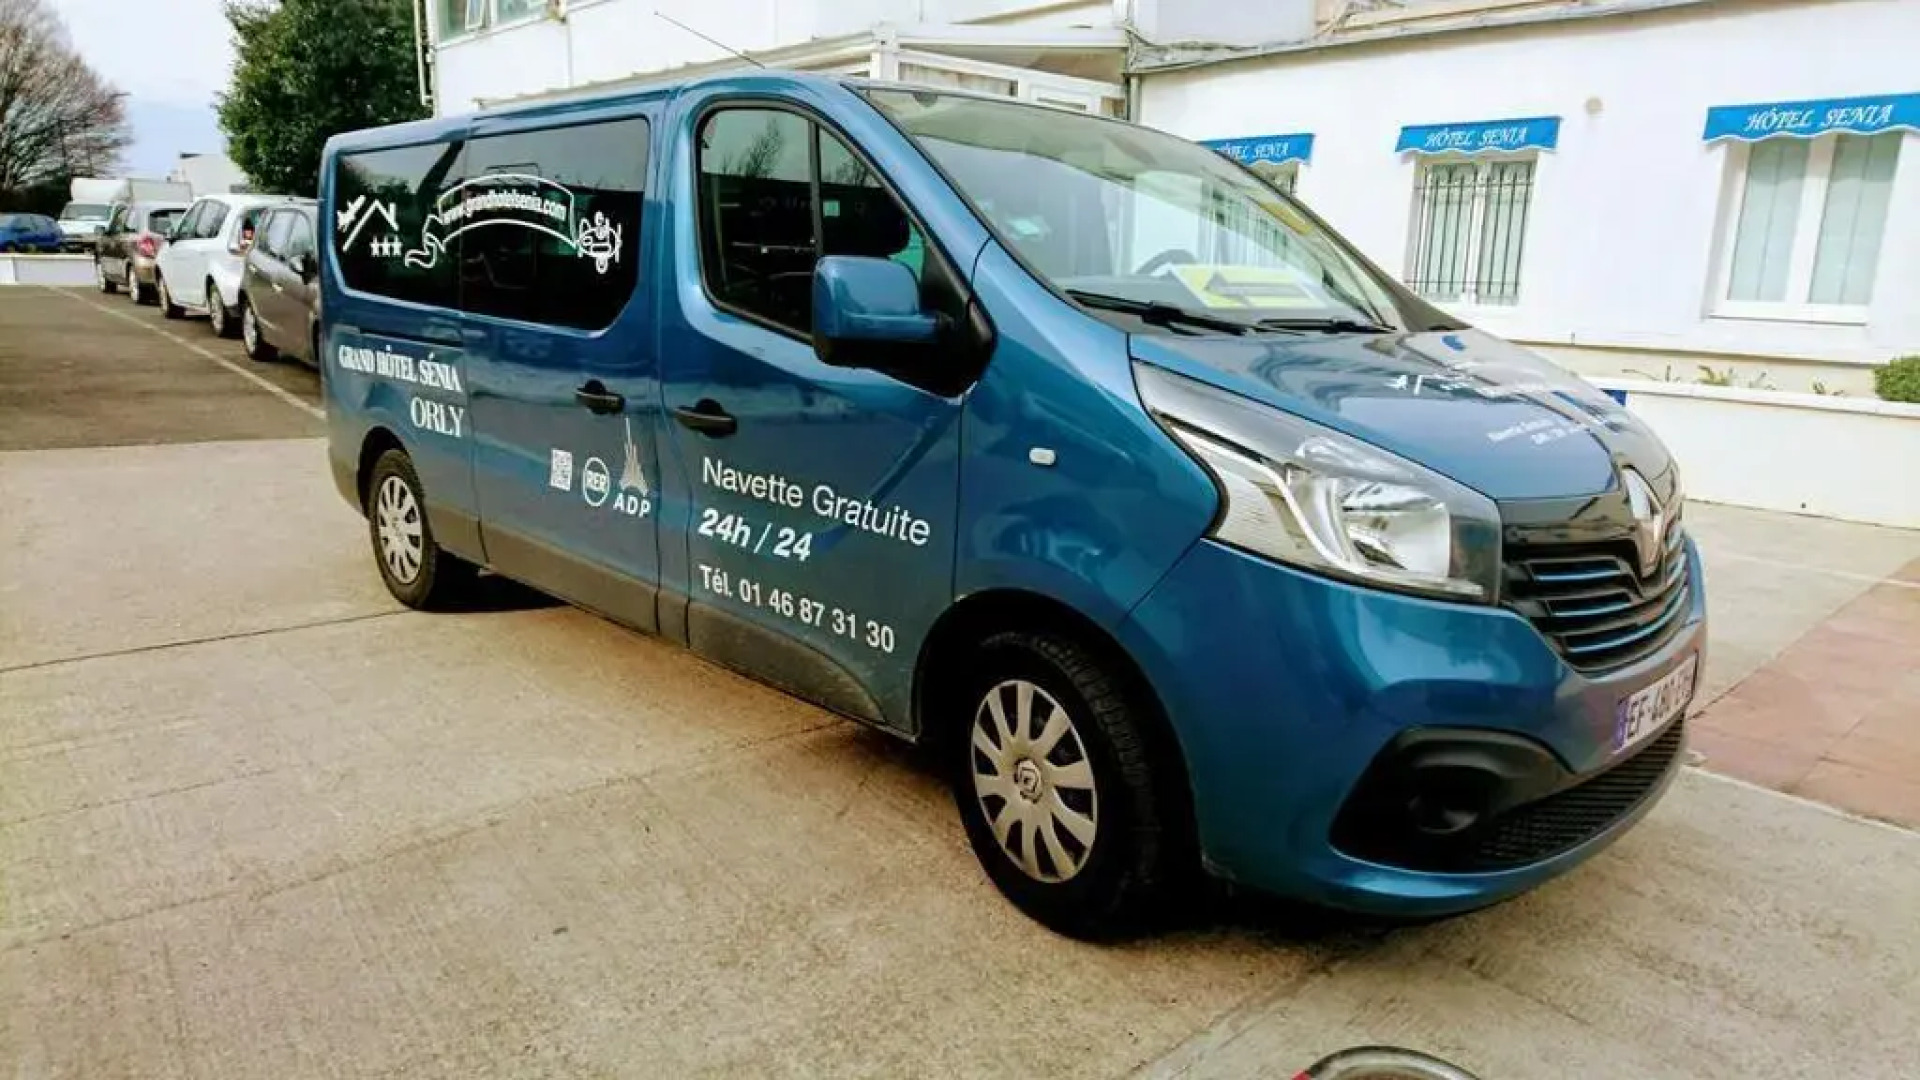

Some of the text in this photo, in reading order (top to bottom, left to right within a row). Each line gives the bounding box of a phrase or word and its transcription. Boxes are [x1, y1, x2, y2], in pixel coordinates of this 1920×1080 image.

[338, 344, 463, 393] GRAND HÔTEL SÉNIA
[410, 396, 465, 438] ORLY
[612, 492, 652, 518] ADP
[702, 456, 931, 547] Navette Gratuite
[698, 507, 751, 548] 24h
[772, 526, 813, 562] 24
[699, 564, 896, 654] Tél. 01 46 87 31 30
